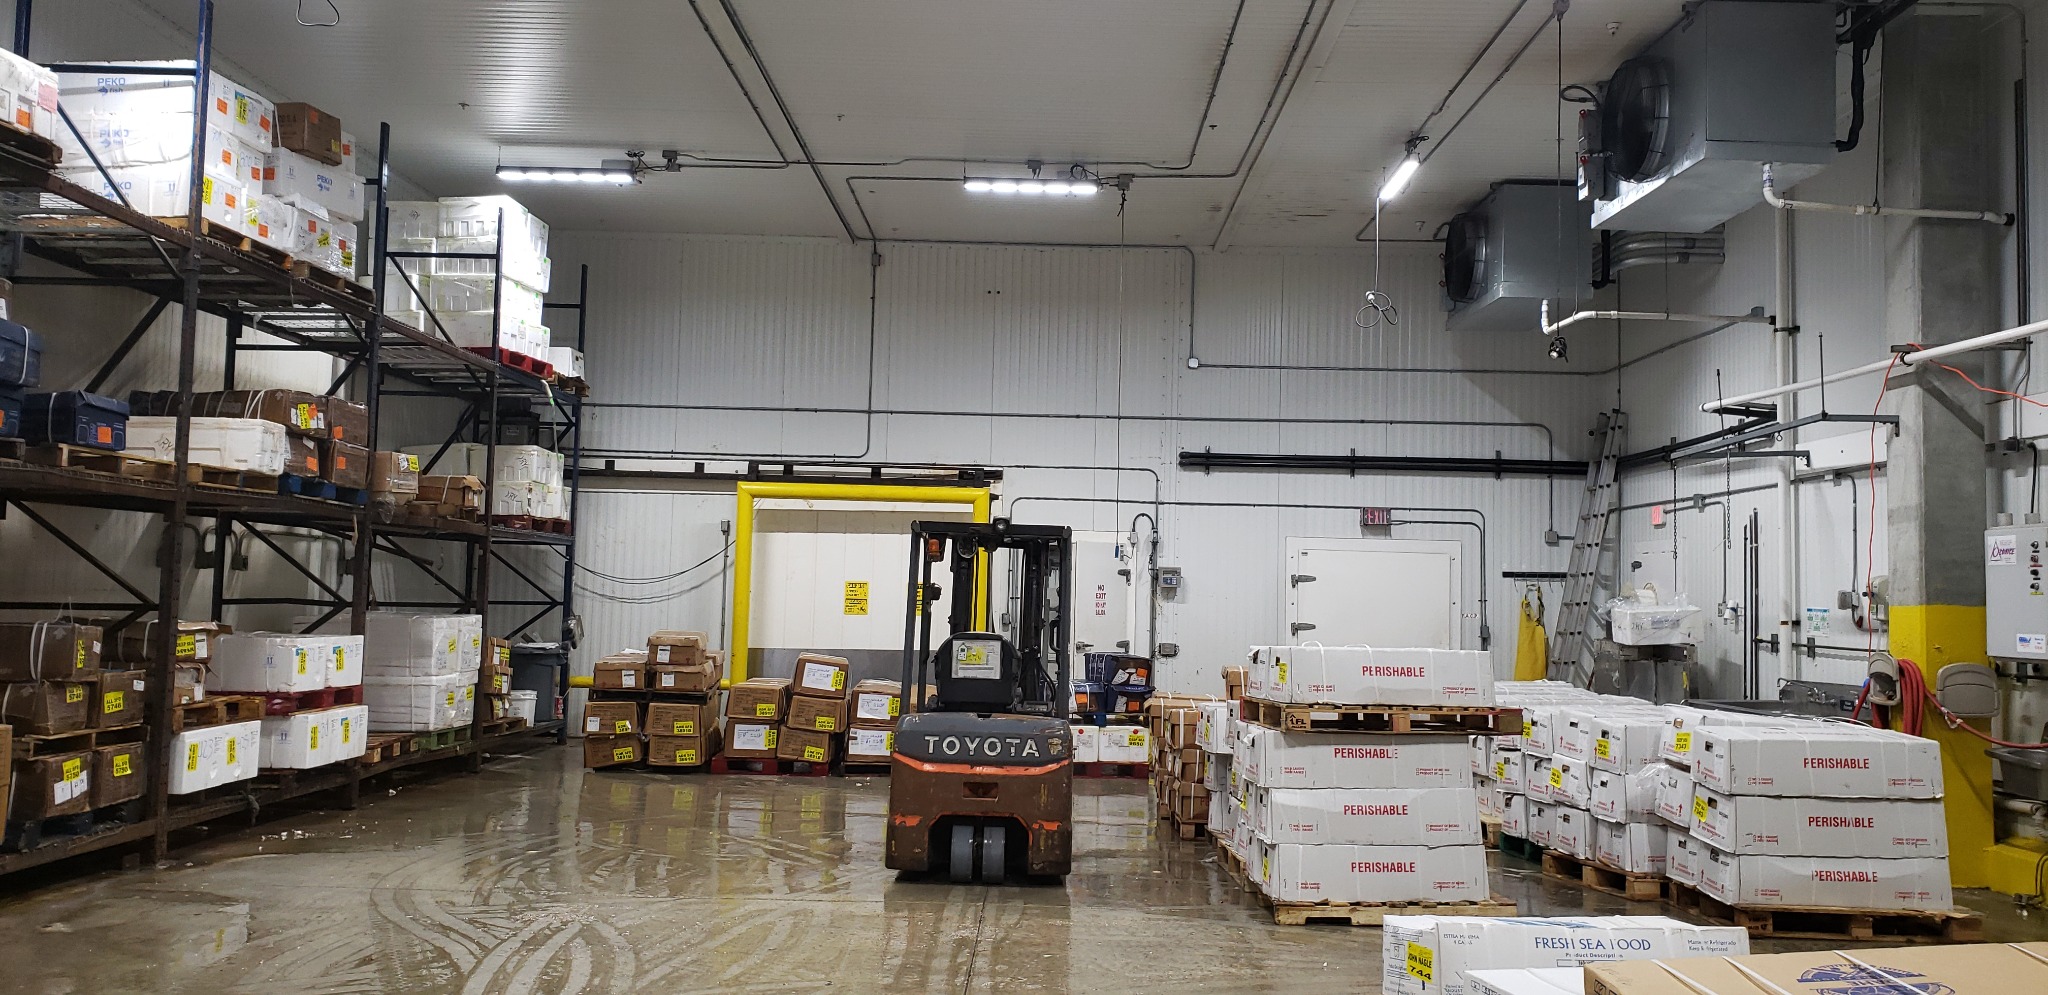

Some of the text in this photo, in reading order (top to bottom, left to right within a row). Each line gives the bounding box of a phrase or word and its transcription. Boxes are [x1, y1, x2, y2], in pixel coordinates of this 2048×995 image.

[98, 78, 126, 86] PEKO
[104, 182, 131, 190] PKO
[1362, 666, 1425, 678] PERISHABLE
[924, 736, 1040, 757] TOYOTA
[1804, 758, 1870, 769] PERISHABLE
[1344, 805, 1408, 816] PERISHABLE
[1808, 817, 1874, 828] PERISHABLE
[1351, 862, 1416, 872] PERISHABLE
[1535, 937, 1575, 949] FRESH
[1579, 939, 1605, 950] SEA
[1408, 953, 1432, 968] JOHN NAGLE
[1410, 965, 1431, 980] 744
